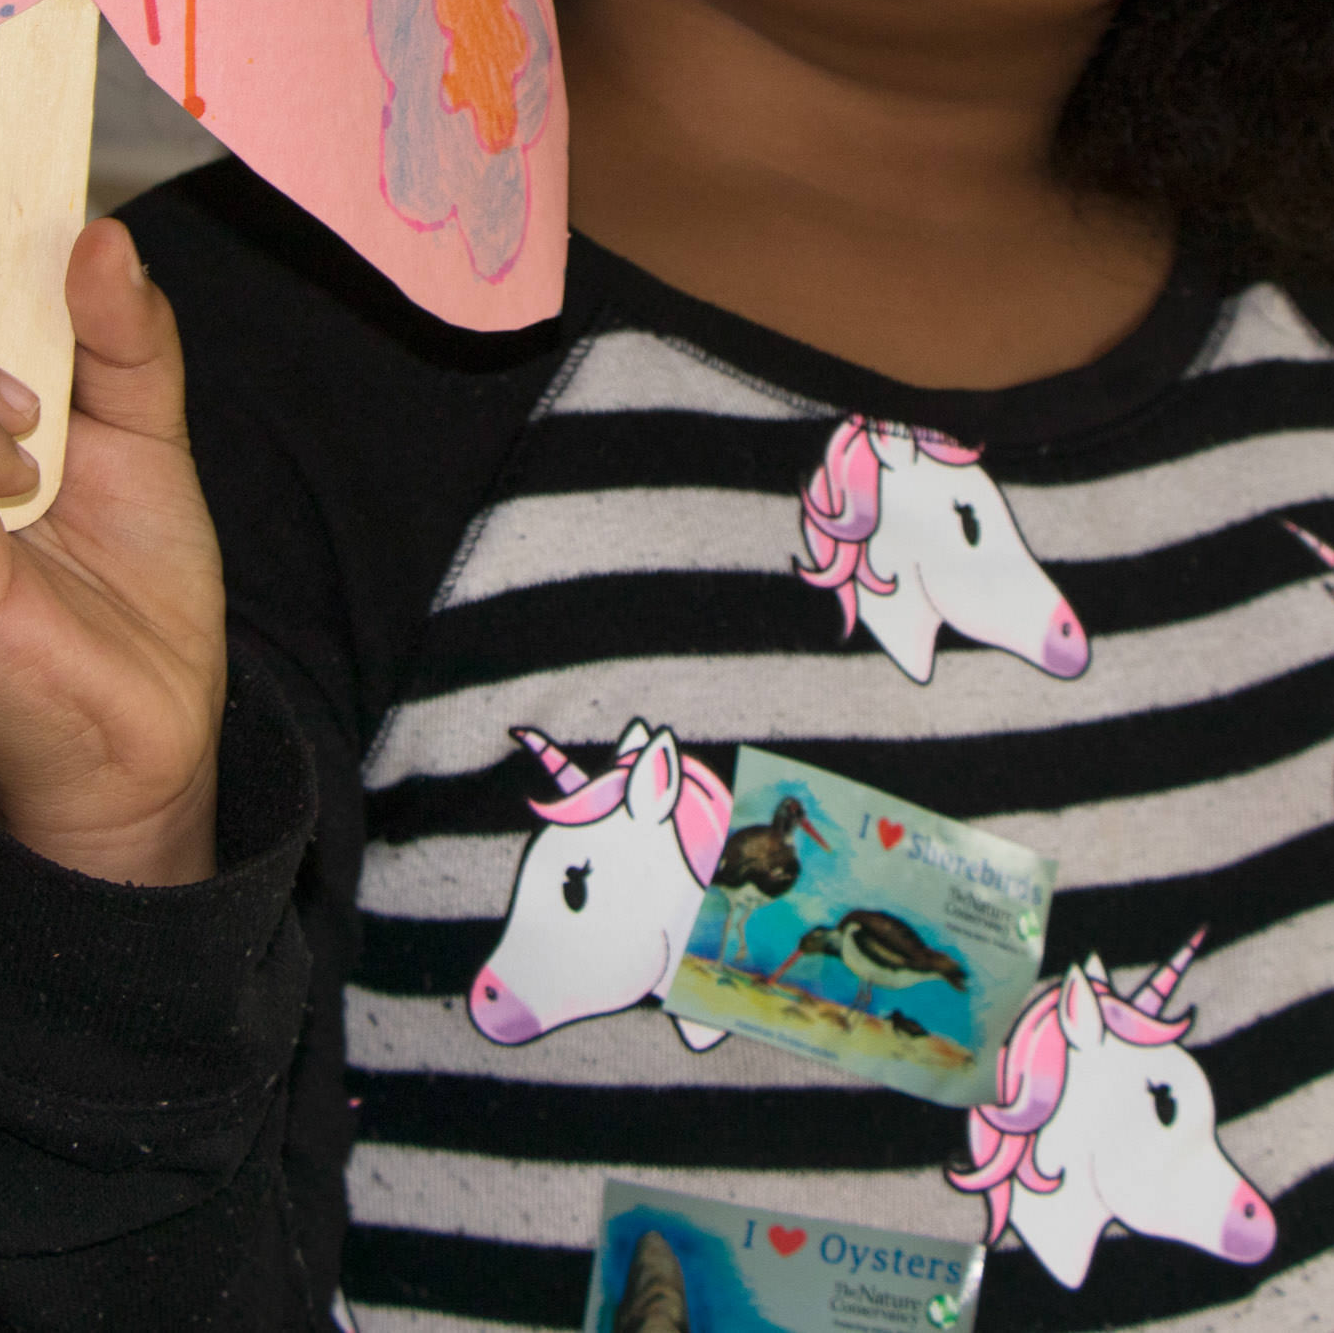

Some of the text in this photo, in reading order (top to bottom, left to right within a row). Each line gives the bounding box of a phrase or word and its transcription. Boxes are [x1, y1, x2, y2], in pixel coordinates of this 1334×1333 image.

[858, 813, 870, 840] I
[743, 1219, 963, 1285] I Oysters
[860, 1283, 923, 1311] Nature
